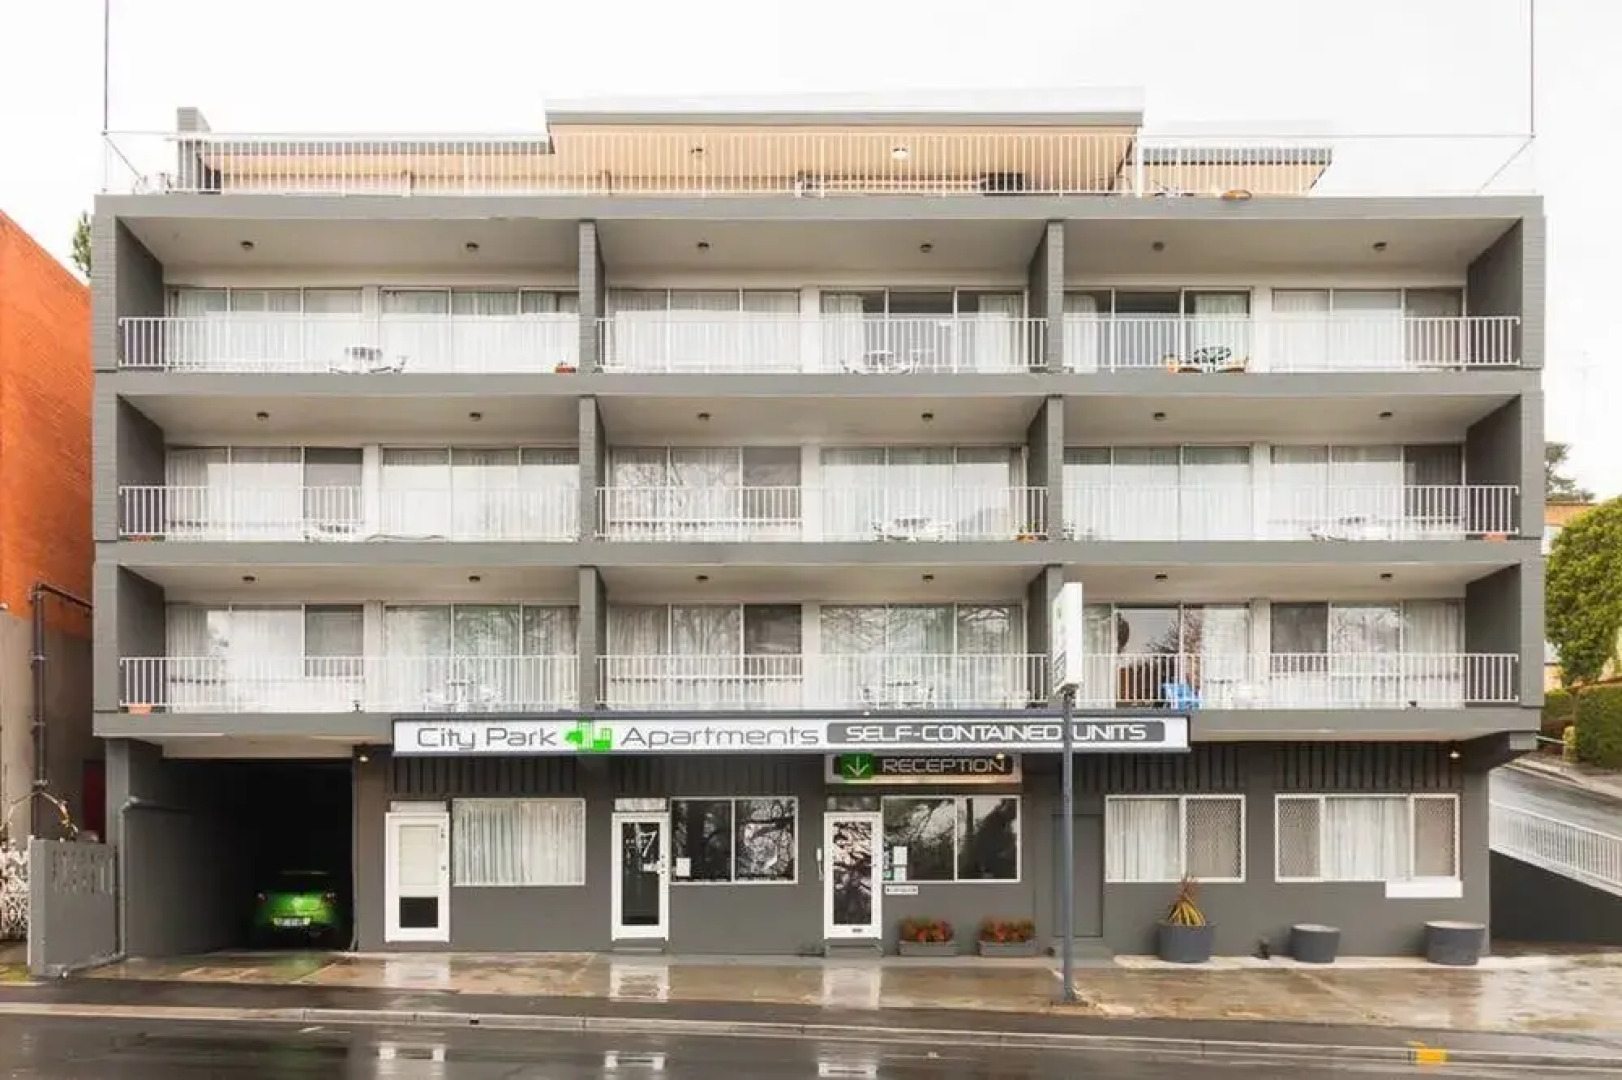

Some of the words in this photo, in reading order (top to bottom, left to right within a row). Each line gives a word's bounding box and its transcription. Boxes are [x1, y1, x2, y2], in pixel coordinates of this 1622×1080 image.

[417, 727, 476, 751] City
[486, 727, 558, 747] Park
[620, 727, 819, 749] Apartments
[845, 724, 1062, 742] SELF-CONTAINED
[1072, 724, 1147, 741] UNITS
[882, 758, 1006, 774] RECEPTION
